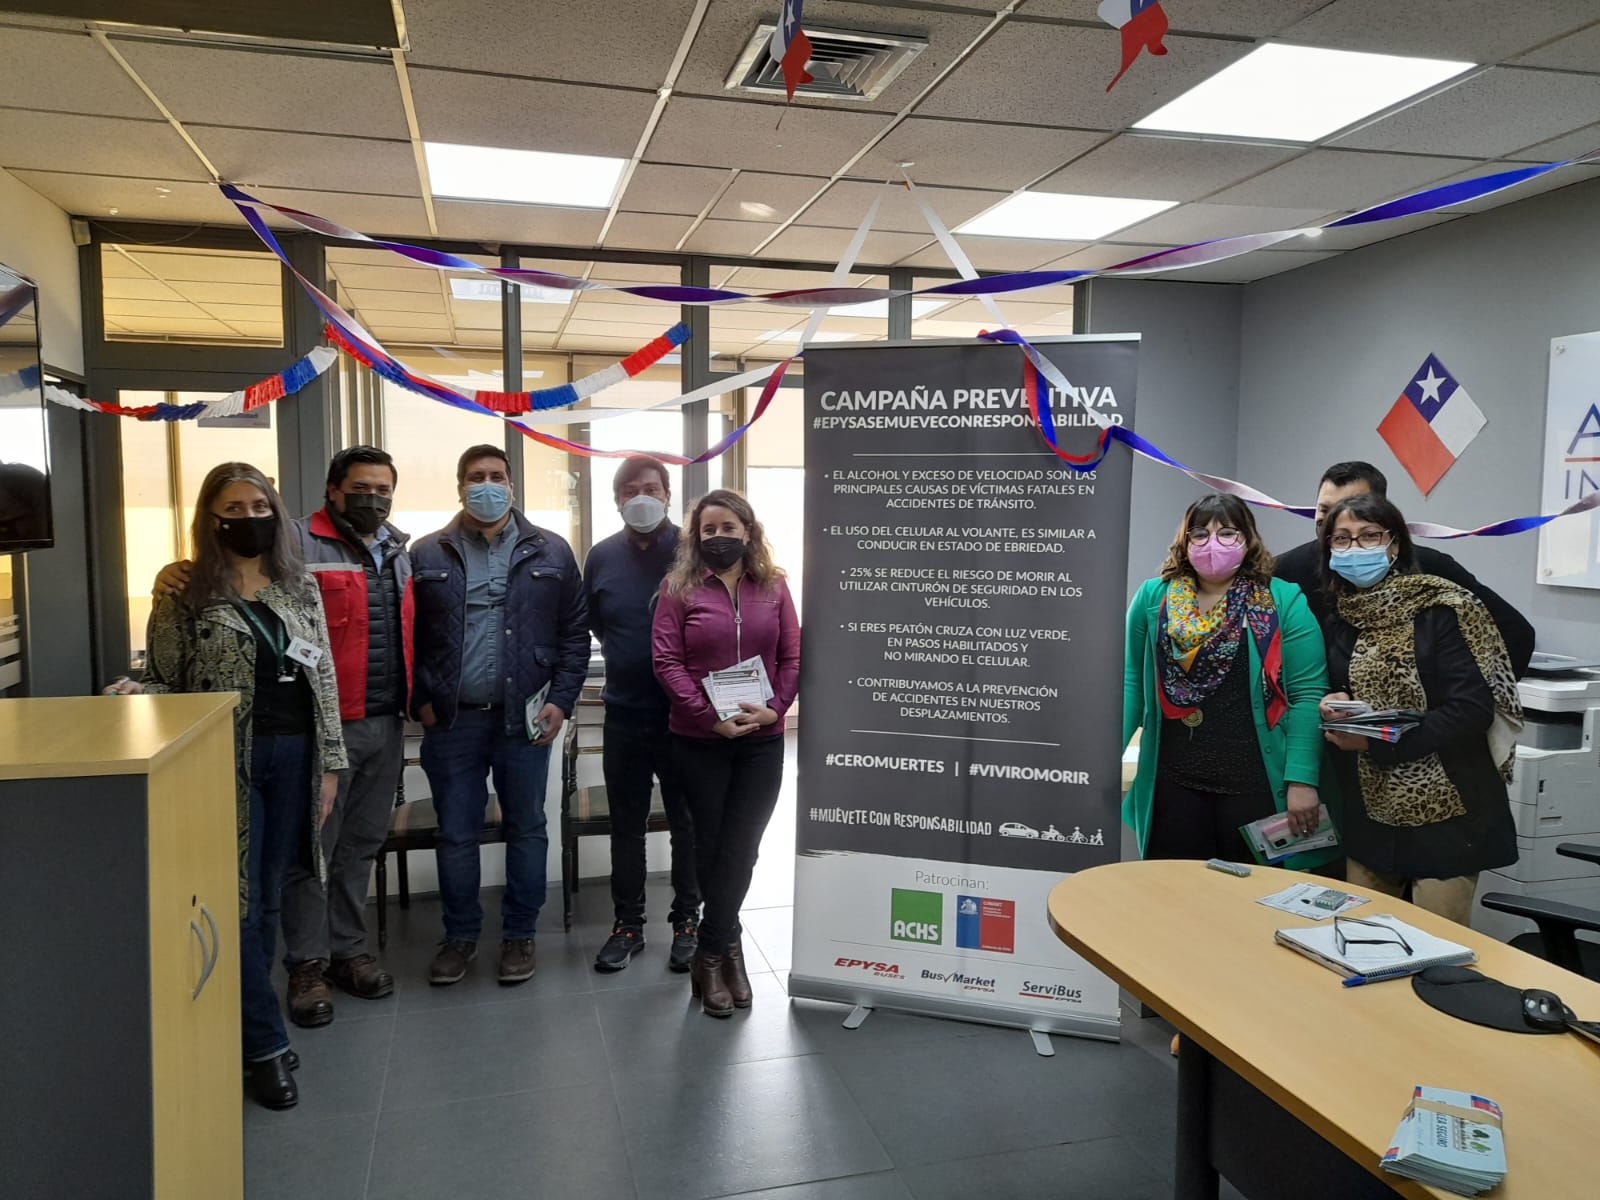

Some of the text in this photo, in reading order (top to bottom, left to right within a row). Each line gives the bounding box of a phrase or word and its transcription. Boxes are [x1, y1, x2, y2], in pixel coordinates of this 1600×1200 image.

[820, 386, 1117, 411] CAMPAÑA PREVETIVA
[833, 470, 1097, 481] EL ALCOHOL Y EXCESO DE VELOCIDAD SON LAS
[834, 482, 1094, 495] PRINCIPALES CAUSAS DE VÍCTIMAS FATALES EN
[886, 497, 1037, 510] ACCIDENTES DE TRÁNSITO.
[831, 526, 1096, 539] EL USO DEL CELULAR AL VOLANTE, ES SIMILAR A
[857, 539, 1065, 553] CONDUCIR EN ESTADO DE EBRIEDAD.
[850, 568, 1072, 582] 25% SE REDUCE EL RIESGO DE MORIR AL
[840, 580, 1082, 596] UTILIZAR CINTURÓN DE SEGURIDAD EN LOS
[924, 595, 991, 609] VEHÍCULOS.
[848, 622, 1071, 641] SI ERES PEATÓN CRUZA CON LUZ VERDE,
[888, 638, 1028, 652] EN PASOS HABILITADOS Y
[884, 651, 1030, 667] NO MIRANDO EL CELULAR.
[857, 677, 1057, 697] CONTRIBUYAMOS A LA PREVENCIÓN
[873, 692, 1040, 711] DE ACCIDENTES EN NUESTROS
[900, 707, 1010, 723] DESPLAZAMIENTOS.
[826, 754, 1089, 785] #CEROMUERTES #VIVIROMORIR
[810, 808, 992, 835] #MUÉVETE CON RESPONSABILIDAD
[916, 870, 989, 890] Patrocinan:
[894, 920, 938, 941] ACHS
[834, 958, 900, 973] EPYSA
[1022, 981, 1082, 998] ServiBus
